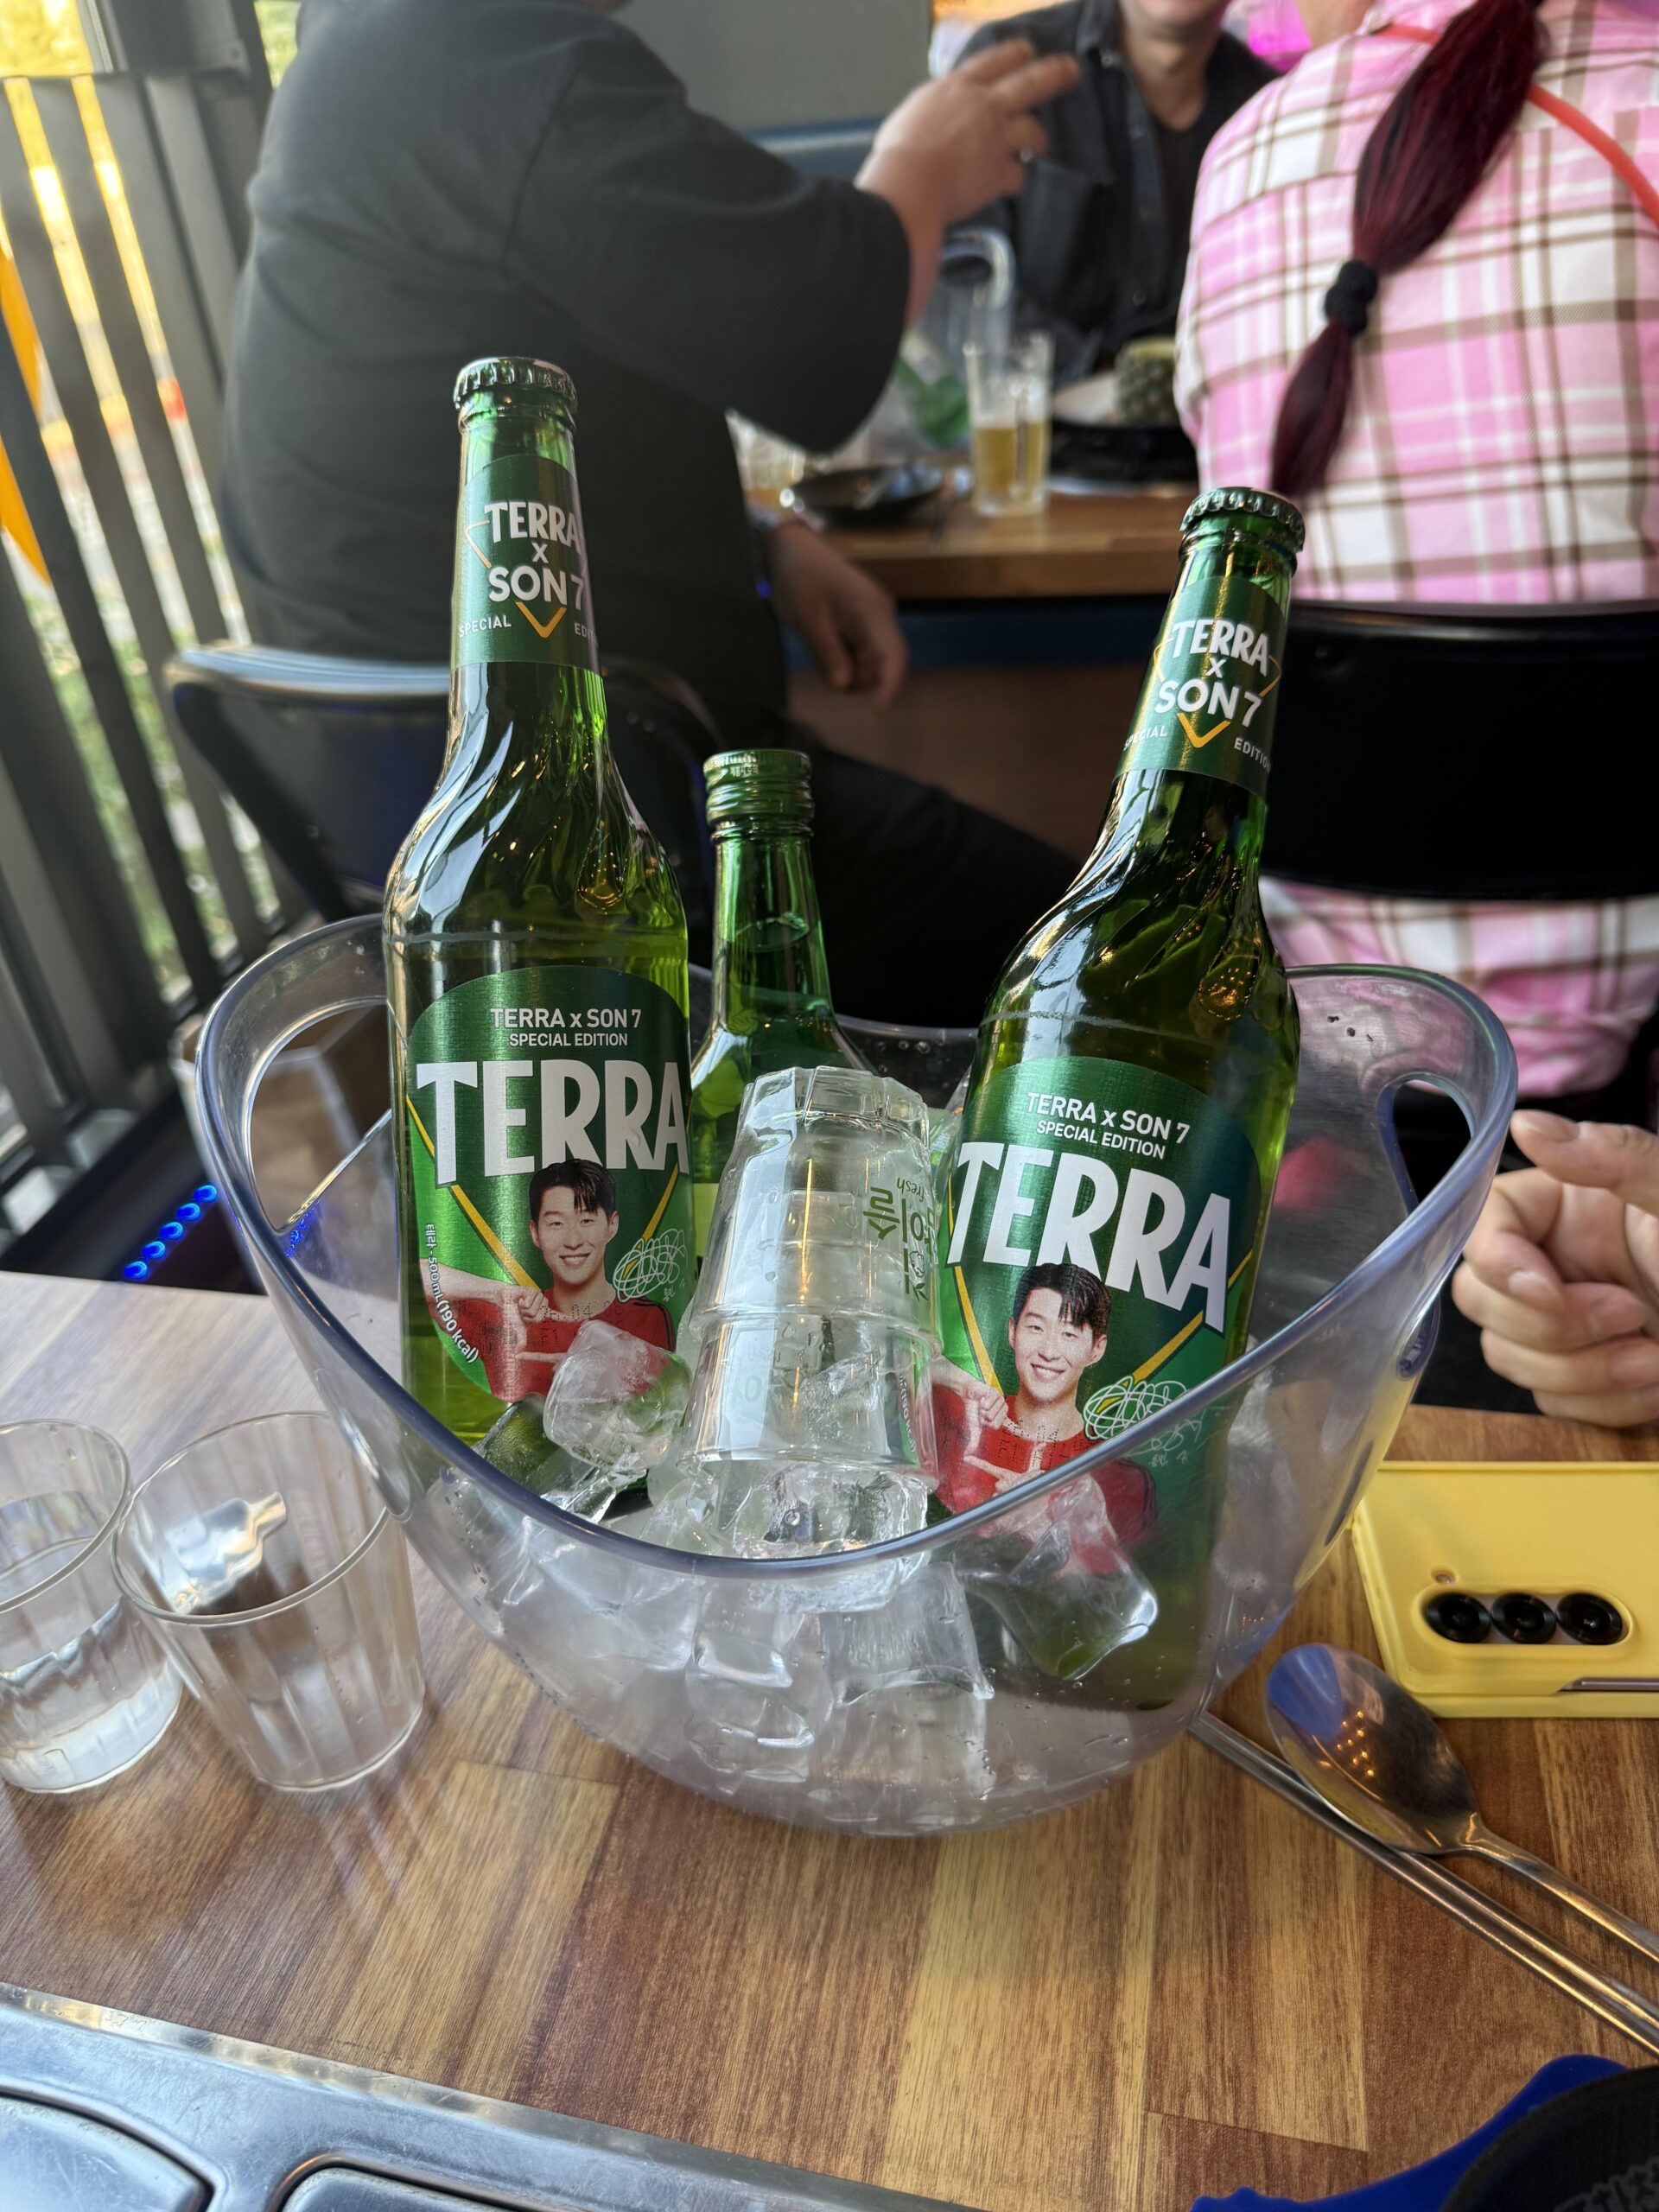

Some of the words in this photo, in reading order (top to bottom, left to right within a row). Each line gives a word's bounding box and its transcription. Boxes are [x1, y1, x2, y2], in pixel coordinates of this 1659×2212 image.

[484, 500, 583, 555] TERRA
[488, 566, 568, 606] SON
[570, 574, 585, 611] 7
[459, 614, 512, 639] SPECIAL
[1172, 619, 1268, 677] TERRA
[1154, 678, 1239, 720] SON
[1242, 691, 1262, 728] 7
[1123, 725, 1167, 750] SPECIAL
[1234, 737, 1272, 775] EDITION
[490, 1008, 564, 1029] TERRA
[587, 1008, 626, 1029] SON
[632, 1009, 641, 1028] 7
[508, 1033, 571, 1047] SPECIAL
[574, 1033, 628, 1046] EDITION
[416, 1058, 690, 1186] TERRA
[1026, 1091, 1096, 1124] TERRA
[1120, 1109, 1172, 1141] SON
[1176, 1122, 1191, 1144] 7
[1036, 1119, 1098, 1147] SPECIAL
[1101, 1132, 1166, 1160] EDITION
[897, 1177, 925, 1203] fresh
[946, 1141, 1231, 1333] TERRA
[425, 1224, 437, 1247] 테라
[451, 1328, 480, 1364] kcal)
